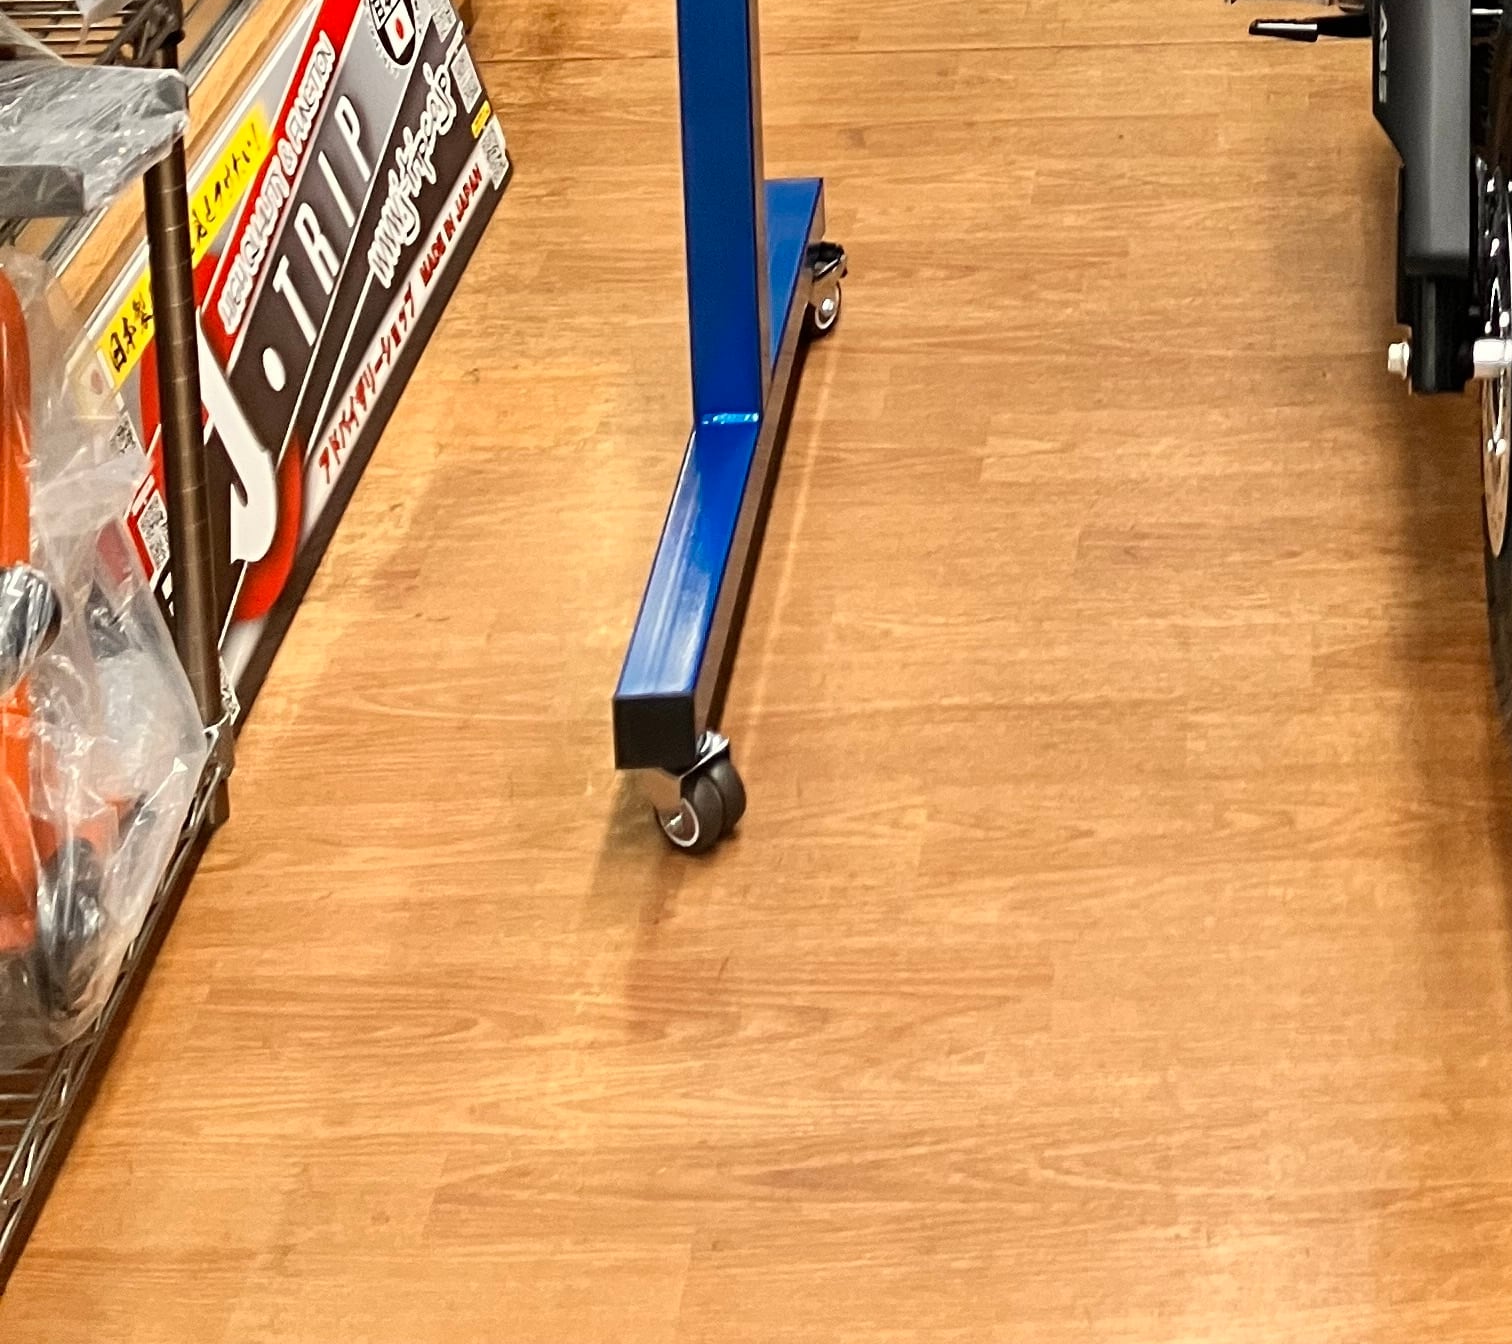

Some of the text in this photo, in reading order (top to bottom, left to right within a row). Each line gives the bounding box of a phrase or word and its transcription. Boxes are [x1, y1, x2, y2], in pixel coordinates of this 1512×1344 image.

[286, 29, 336, 154] FUNCTION
[455, 161, 483, 223] JAPAN
[318, 282, 416, 484] アドバイザリーショップ
